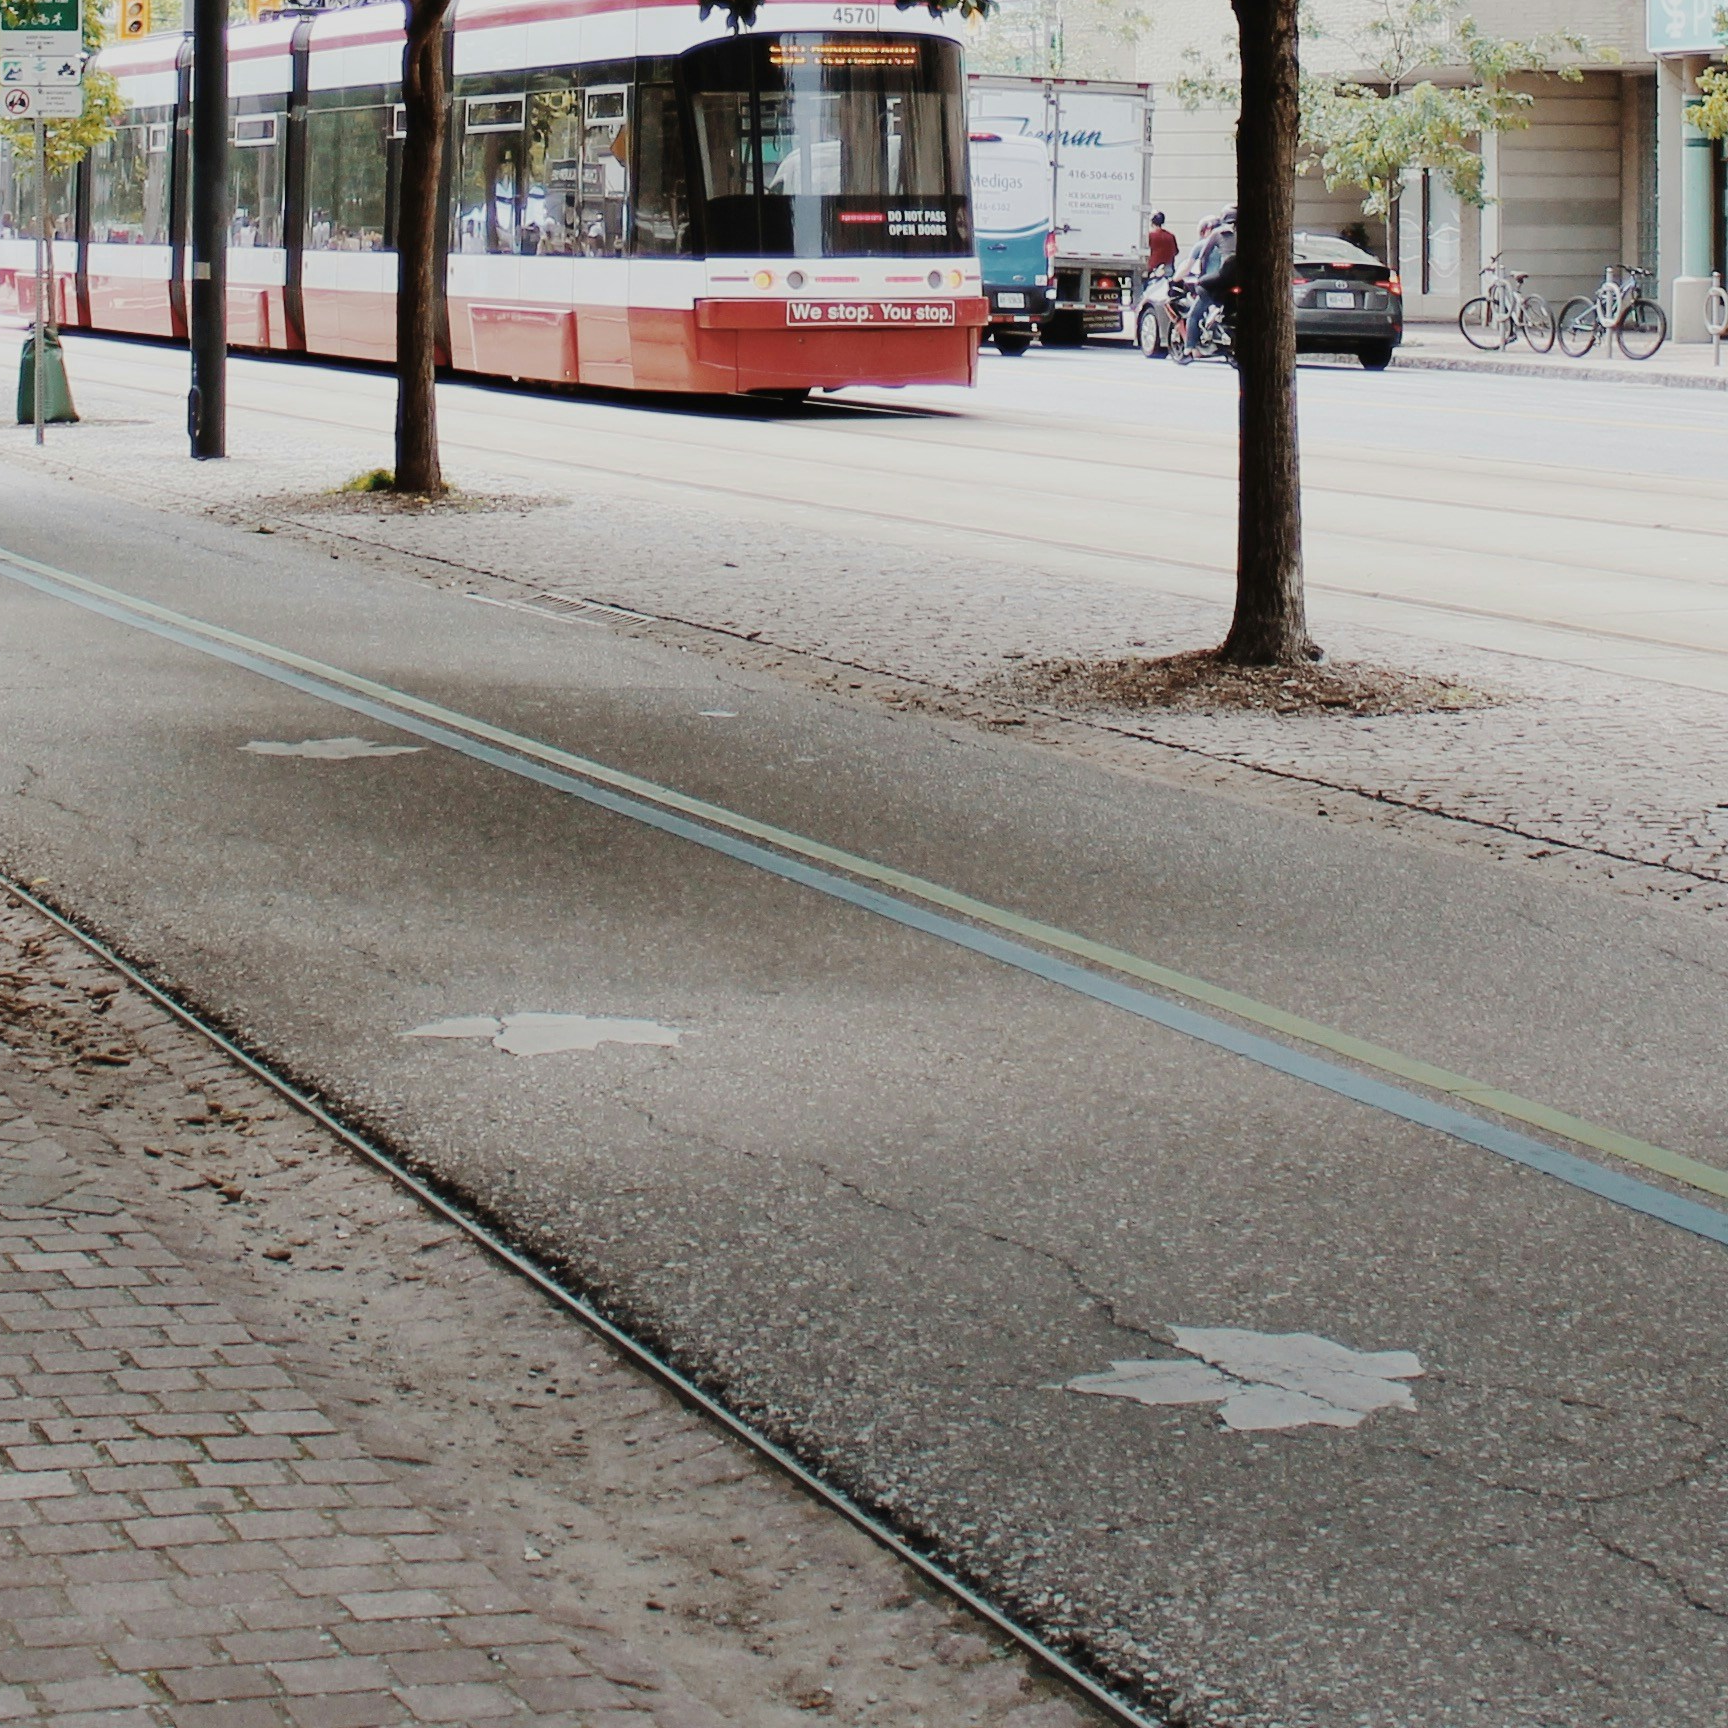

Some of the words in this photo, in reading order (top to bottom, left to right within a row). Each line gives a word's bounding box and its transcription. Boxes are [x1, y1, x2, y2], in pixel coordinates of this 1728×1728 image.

[833, 7, 876, 23] 4570
[887, 210, 902, 223] DO
[904, 210, 922, 223] NOT
[924, 210, 946, 223] PASS
[888, 224, 916, 236] OPEN
[917, 224, 948, 236] DOORS
[792, 304, 822, 320] We
[828, 304, 874, 323] stop.
[880, 304, 912, 320] You
[915, 305, 952, 323] stop.
